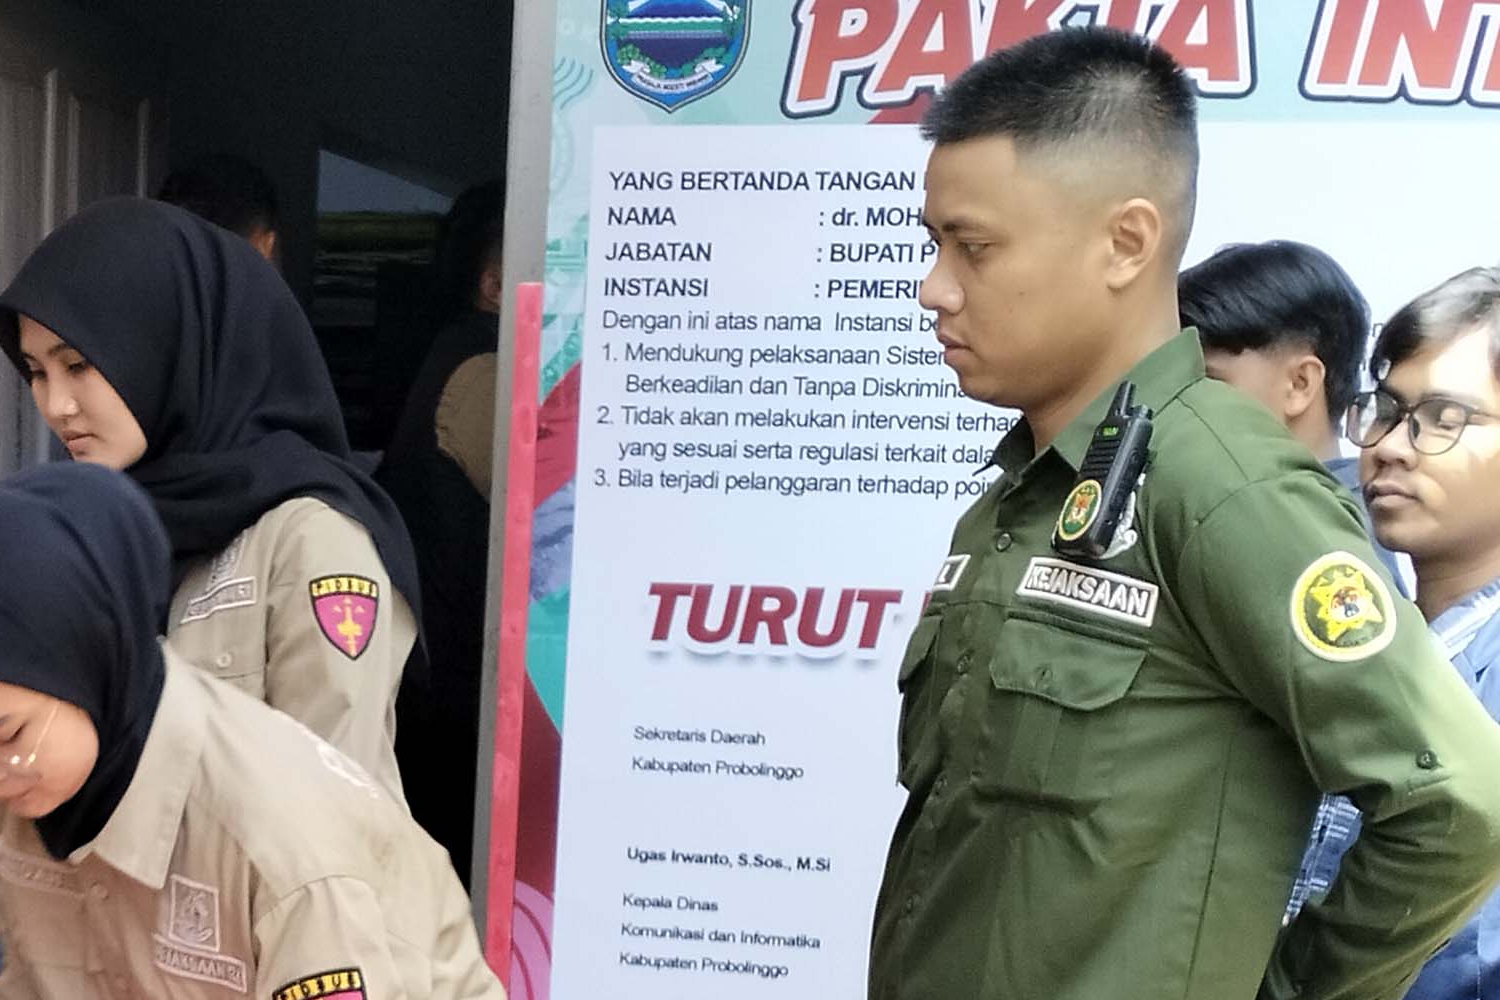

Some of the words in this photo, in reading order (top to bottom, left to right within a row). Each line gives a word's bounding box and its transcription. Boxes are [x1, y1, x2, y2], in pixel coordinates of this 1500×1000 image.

[1298, 0, 1500, 110] IN
[609, 171, 673, 191] YANG
[680, 171, 810, 191] BERTANDA
[815, 171, 916, 191] TANGAN
[608, 206, 677, 226] NAMA
[831, 207, 859, 227] dr.
[866, 208, 921, 227] MOH
[605, 242, 712, 262] JABATAN
[829, 243, 914, 263] BUPATI
[920, 244, 935, 262] P
[604, 277, 709, 297] INSTANSI
[828, 280, 923, 299] PEMERI
[602, 309, 682, 335] Dengan
[687, 314, 710, 331] ini
[715, 314, 758, 331] atas
[763, 315, 822, 331] nama
[835, 311, 913, 332] Instansi
[602, 343, 618, 361] 1.
[625, 342, 744, 368] Mendukung
[749, 344, 880, 369] pelaksanaan
[886, 347, 944, 365] Siste
[625, 373, 743, 395] Berkeadilan
[749, 376, 788, 396] dan
[793, 376, 856, 401] Tanpa
[597, 405, 614, 425] 2.
[620, 405, 675, 426] Tidak
[679, 407, 729, 427] akan
[734, 408, 846, 429] melakukan
[851, 409, 950, 431] intervensi
[618, 441, 667, 462] yang
[672, 439, 737, 458] sesuai
[742, 441, 793, 460] serta
[799, 442, 879, 466] regulasi
[884, 443, 947, 464] terkait
[952, 446, 994, 465] dala
[594, 468, 611, 487] 3.
[618, 468, 654, 488] Bila
[659, 471, 719, 494] terjadi
[724, 471, 851, 497] pelanggaran
[857, 474, 949, 500] terhadap
[954, 477, 990, 499] poi
[649, 582, 902, 649] TURUT
[634, 726, 707, 743] Sekretaris
[710, 729, 766, 745] Daerah
[632, 758, 711, 775] Kabupaten
[715, 760, 804, 781] Probolinggo
[627, 847, 667, 864] Ugas
[671, 849, 733, 868] Irwanto,
[737, 853, 792, 871] S.Sos.,
[796, 856, 831, 872] M.Si
[622, 894, 673, 911] Kepala
[676, 896, 719, 911] Dinas
[621, 923, 705, 941] Komunikasi
[708, 929, 736, 943] dan
[740, 931, 821, 949] Informatika
[619, 953, 698, 971] Kabupaten
[701, 958, 789, 979] Probolinggo
